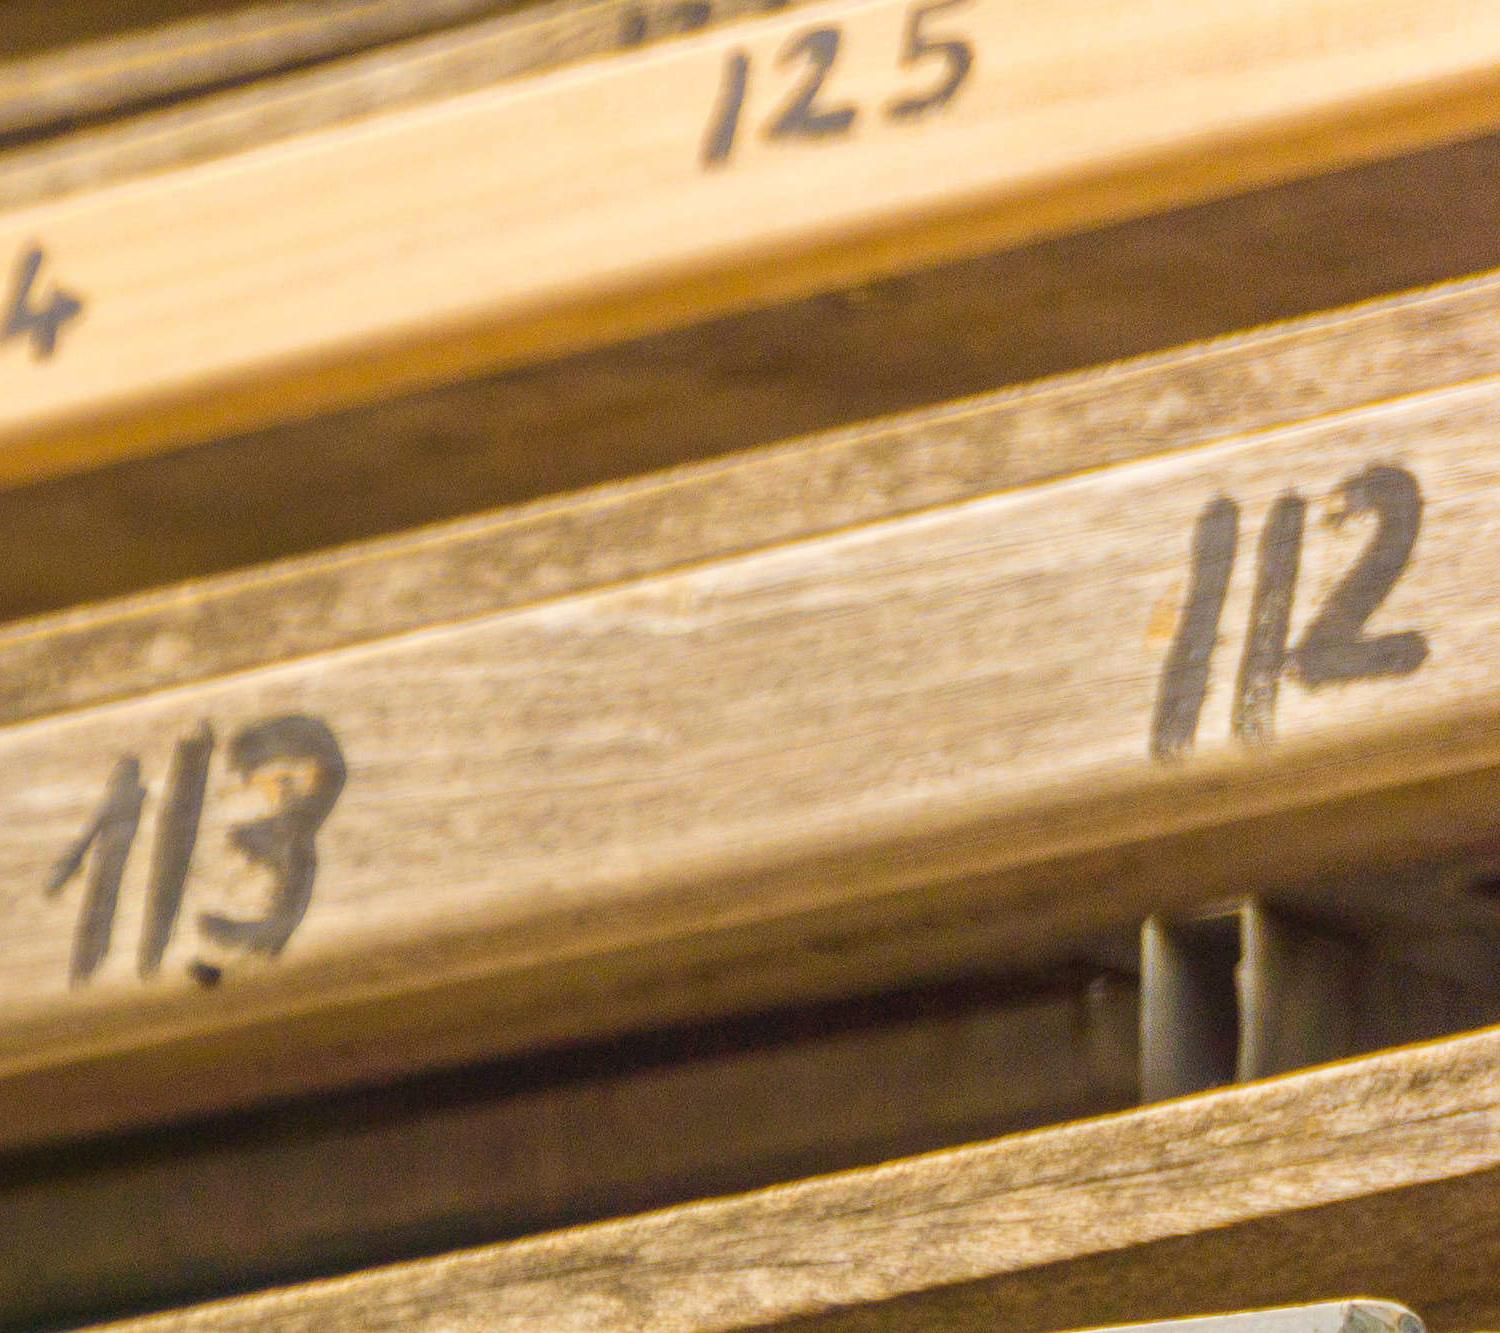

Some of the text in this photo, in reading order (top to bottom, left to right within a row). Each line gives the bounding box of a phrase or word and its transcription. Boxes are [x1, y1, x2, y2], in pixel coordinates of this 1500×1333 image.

[699, 0, 975, 168] 125
[1150, 463, 1431, 760] 112
[45, 714, 347, 990] 113
